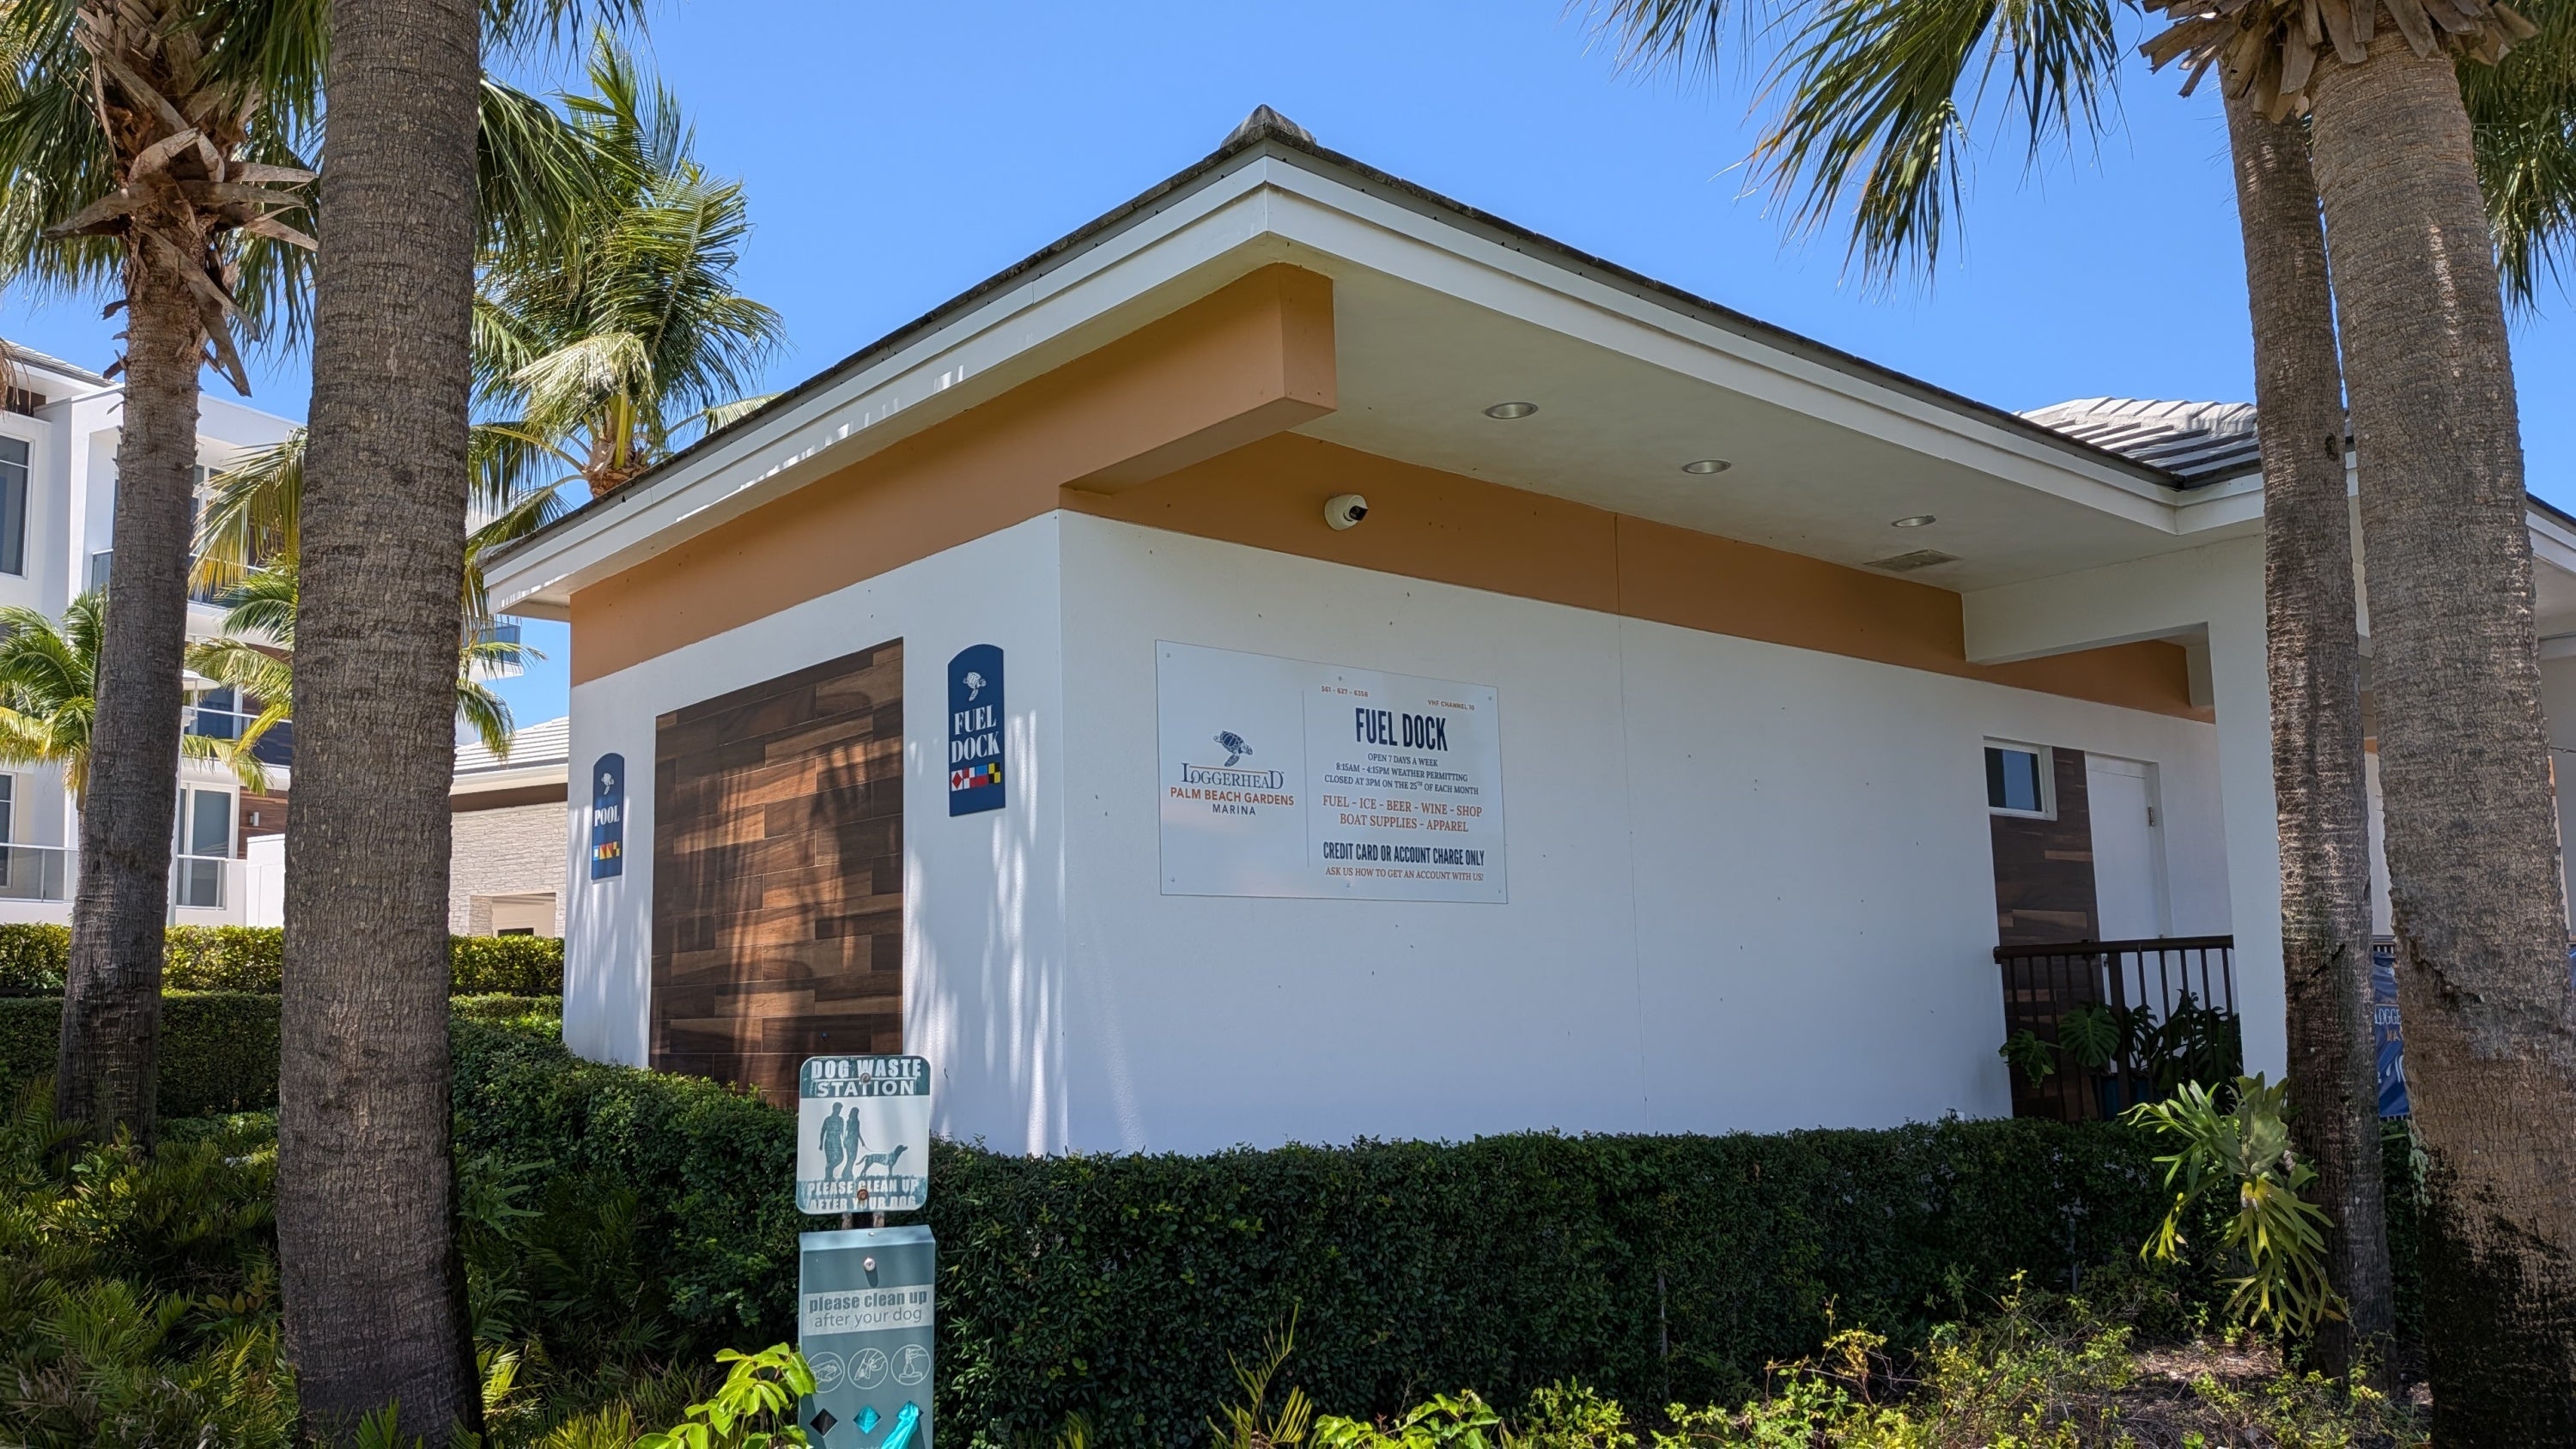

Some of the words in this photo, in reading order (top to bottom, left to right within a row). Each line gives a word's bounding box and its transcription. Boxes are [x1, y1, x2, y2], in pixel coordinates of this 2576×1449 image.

[1441, 700, 1467, 710] CHANNEL
[955, 705, 997, 736] FUEL
[1356, 707, 1398, 746] FUEL
[1402, 713, 1448, 751] DOCK
[951, 731, 1000, 764] DOCK
[1368, 753, 1387, 761] OPEN
[1394, 755, 1411, 764] DAYS
[1419, 758, 1438, 767] WEEK
[1181, 762, 1284, 789] LOGGERHEAD
[1336, 762, 1360, 773] 8:15AM
[1367, 765, 1389, 775] 4:15PM
[1391, 767, 1425, 779] WEATHER
[1426, 771, 1467, 782] PERMITTING
[1324, 774, 1353, 785] CLOSED
[1365, 778, 1381, 787] 3PM
[1382, 779, 1393, 788] ON
[1394, 780, 1408, 790] THE
[1424, 783, 1433, 791] OF
[1435, 784, 1452, 793] EACH
[1454, 785, 1479, 795] MONTH
[1170, 786, 1201, 800] PALM
[1204, 789, 1241, 803] BEACH
[1244, 792, 1295, 806] GARDENS
[1323, 795, 1349, 808] FUEL
[1359, 797, 1376, 809] ICE
[1387, 800, 1412, 812] BEER
[1421, 803, 1448, 815] WINE
[1456, 804, 1482, 817] SHOP
[594, 804, 620, 827] POOL
[1212, 803, 1256, 815] MARINA
[1340, 813, 1367, 826] BOAT
[1370, 815, 1418, 829] SUPPLIES
[1426, 820, 1469, 832] APPAREL
[1323, 841, 1353, 859] CREDIT
[1356, 844, 1378, 861] CARD
[1381, 845, 1392, 861] OR
[1394, 846, 1431, 864] ACCOUNT
[1433, 848, 1464, 865] CHARGE
[1466, 850, 1485, 866] ONLY
[1326, 867, 1341, 876] ASK
[1343, 867, 1353, 876] US
[1355, 868, 1374, 876] HOW
[1376, 869, 1386, 877] TO
[1388, 870, 1403, 878] GET
[1404, 870, 1414, 879] AN
[1416, 870, 1450, 880] ACCOUNT
[1452, 872, 1471, 881] WITH
[2374, 1008, 2401, 1026] LOGGE
[811, 1060, 850, 1079] DOG
[857, 1058, 921, 1078] WASTE
[817, 1080, 914, 1097] STATION
[808, 1181, 854, 1196] PLEASE
[859, 1179, 897, 1193] CLEAN
[902, 1179, 918, 1192] UP
[810, 1198, 848, 1210] AFTER
[853, 1197, 885, 1210] YOUR
[890, 1196, 916, 1209] DOG
[809, 1296, 860, 1313] please
[864, 1292, 905, 1307] clean
[909, 1290, 927, 1304] up
[814, 1313, 850, 1328] after
[854, 1311, 889, 1328] your
[893, 1307, 922, 1323] dog
